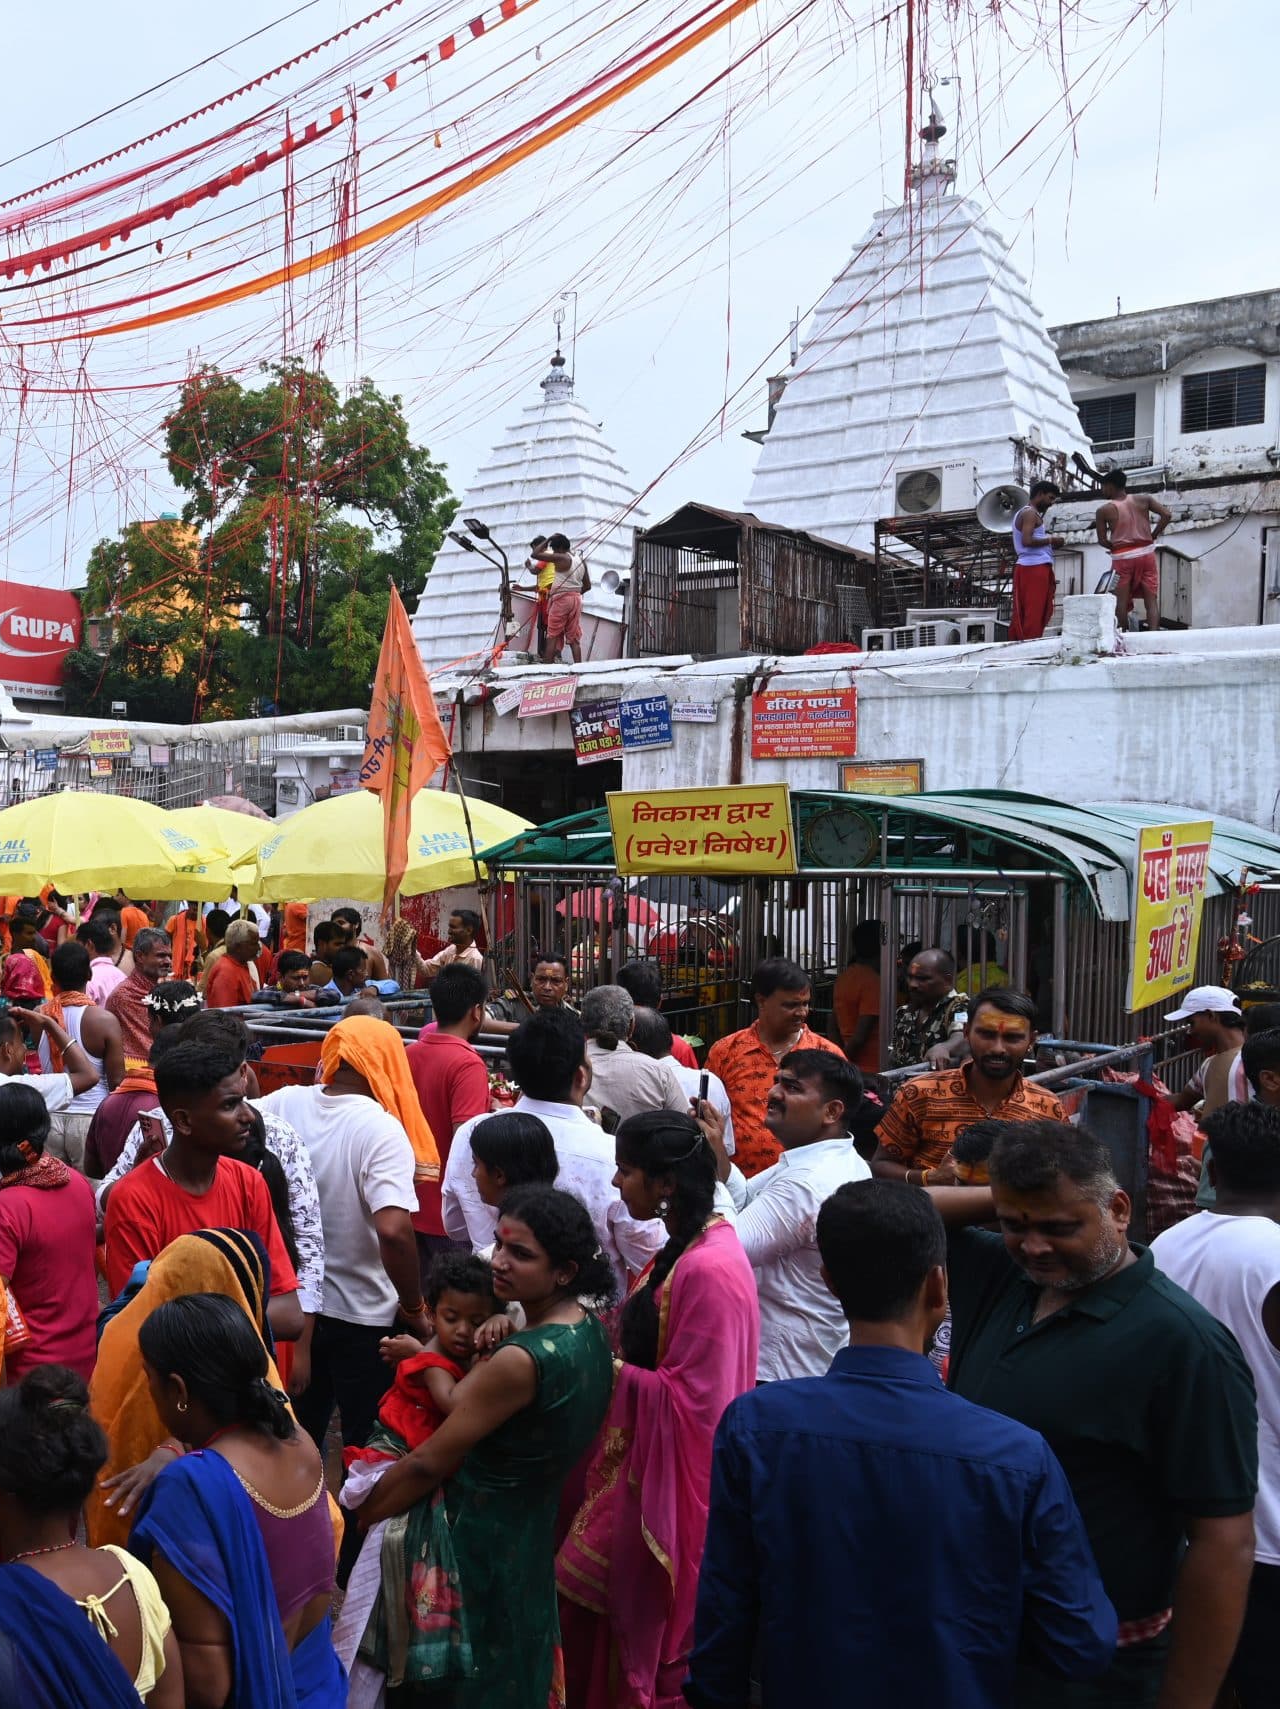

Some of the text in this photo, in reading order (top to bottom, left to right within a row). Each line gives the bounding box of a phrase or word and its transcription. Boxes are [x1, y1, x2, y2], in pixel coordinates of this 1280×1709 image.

[10, 615, 75, 644] RUPA
[644, 698, 666, 713] पंडा
[765, 697, 843, 711] हरिहर पण्डा
[575, 720, 603, 737] भीम
[632, 801, 774, 824] निकास द्वार
[421, 832, 465, 844] LALL
[625, 830, 787, 863] (प्रवेश निषेध)
[1142, 832, 1173, 903] यहाँ
